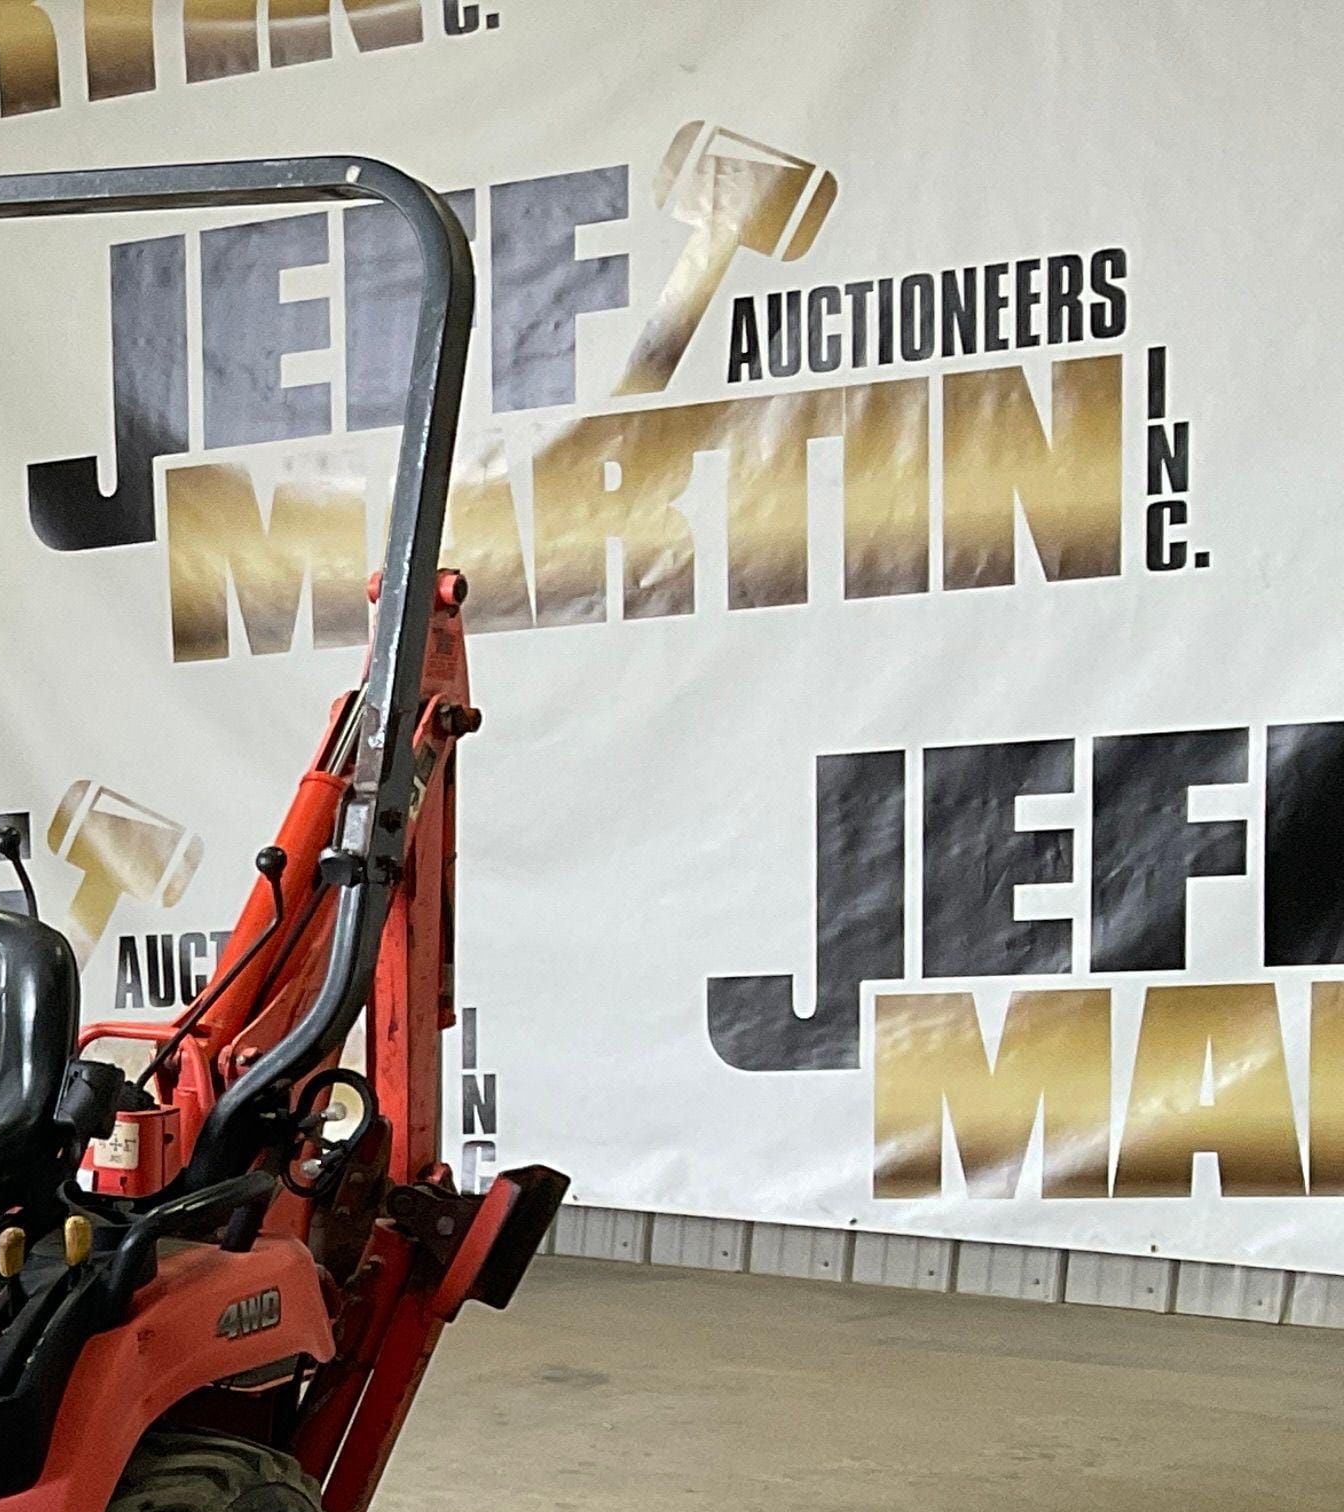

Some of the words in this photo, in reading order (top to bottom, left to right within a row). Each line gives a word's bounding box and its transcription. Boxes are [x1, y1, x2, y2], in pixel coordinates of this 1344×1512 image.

[27, 164, 629, 553] JEFF
[727, 248, 1128, 383] AUCTIONEERS
[1146, 346, 1212, 573] INC.
[873, 980, 1344, 1200] MA
[215, 1286, 281, 1342] 4WD
